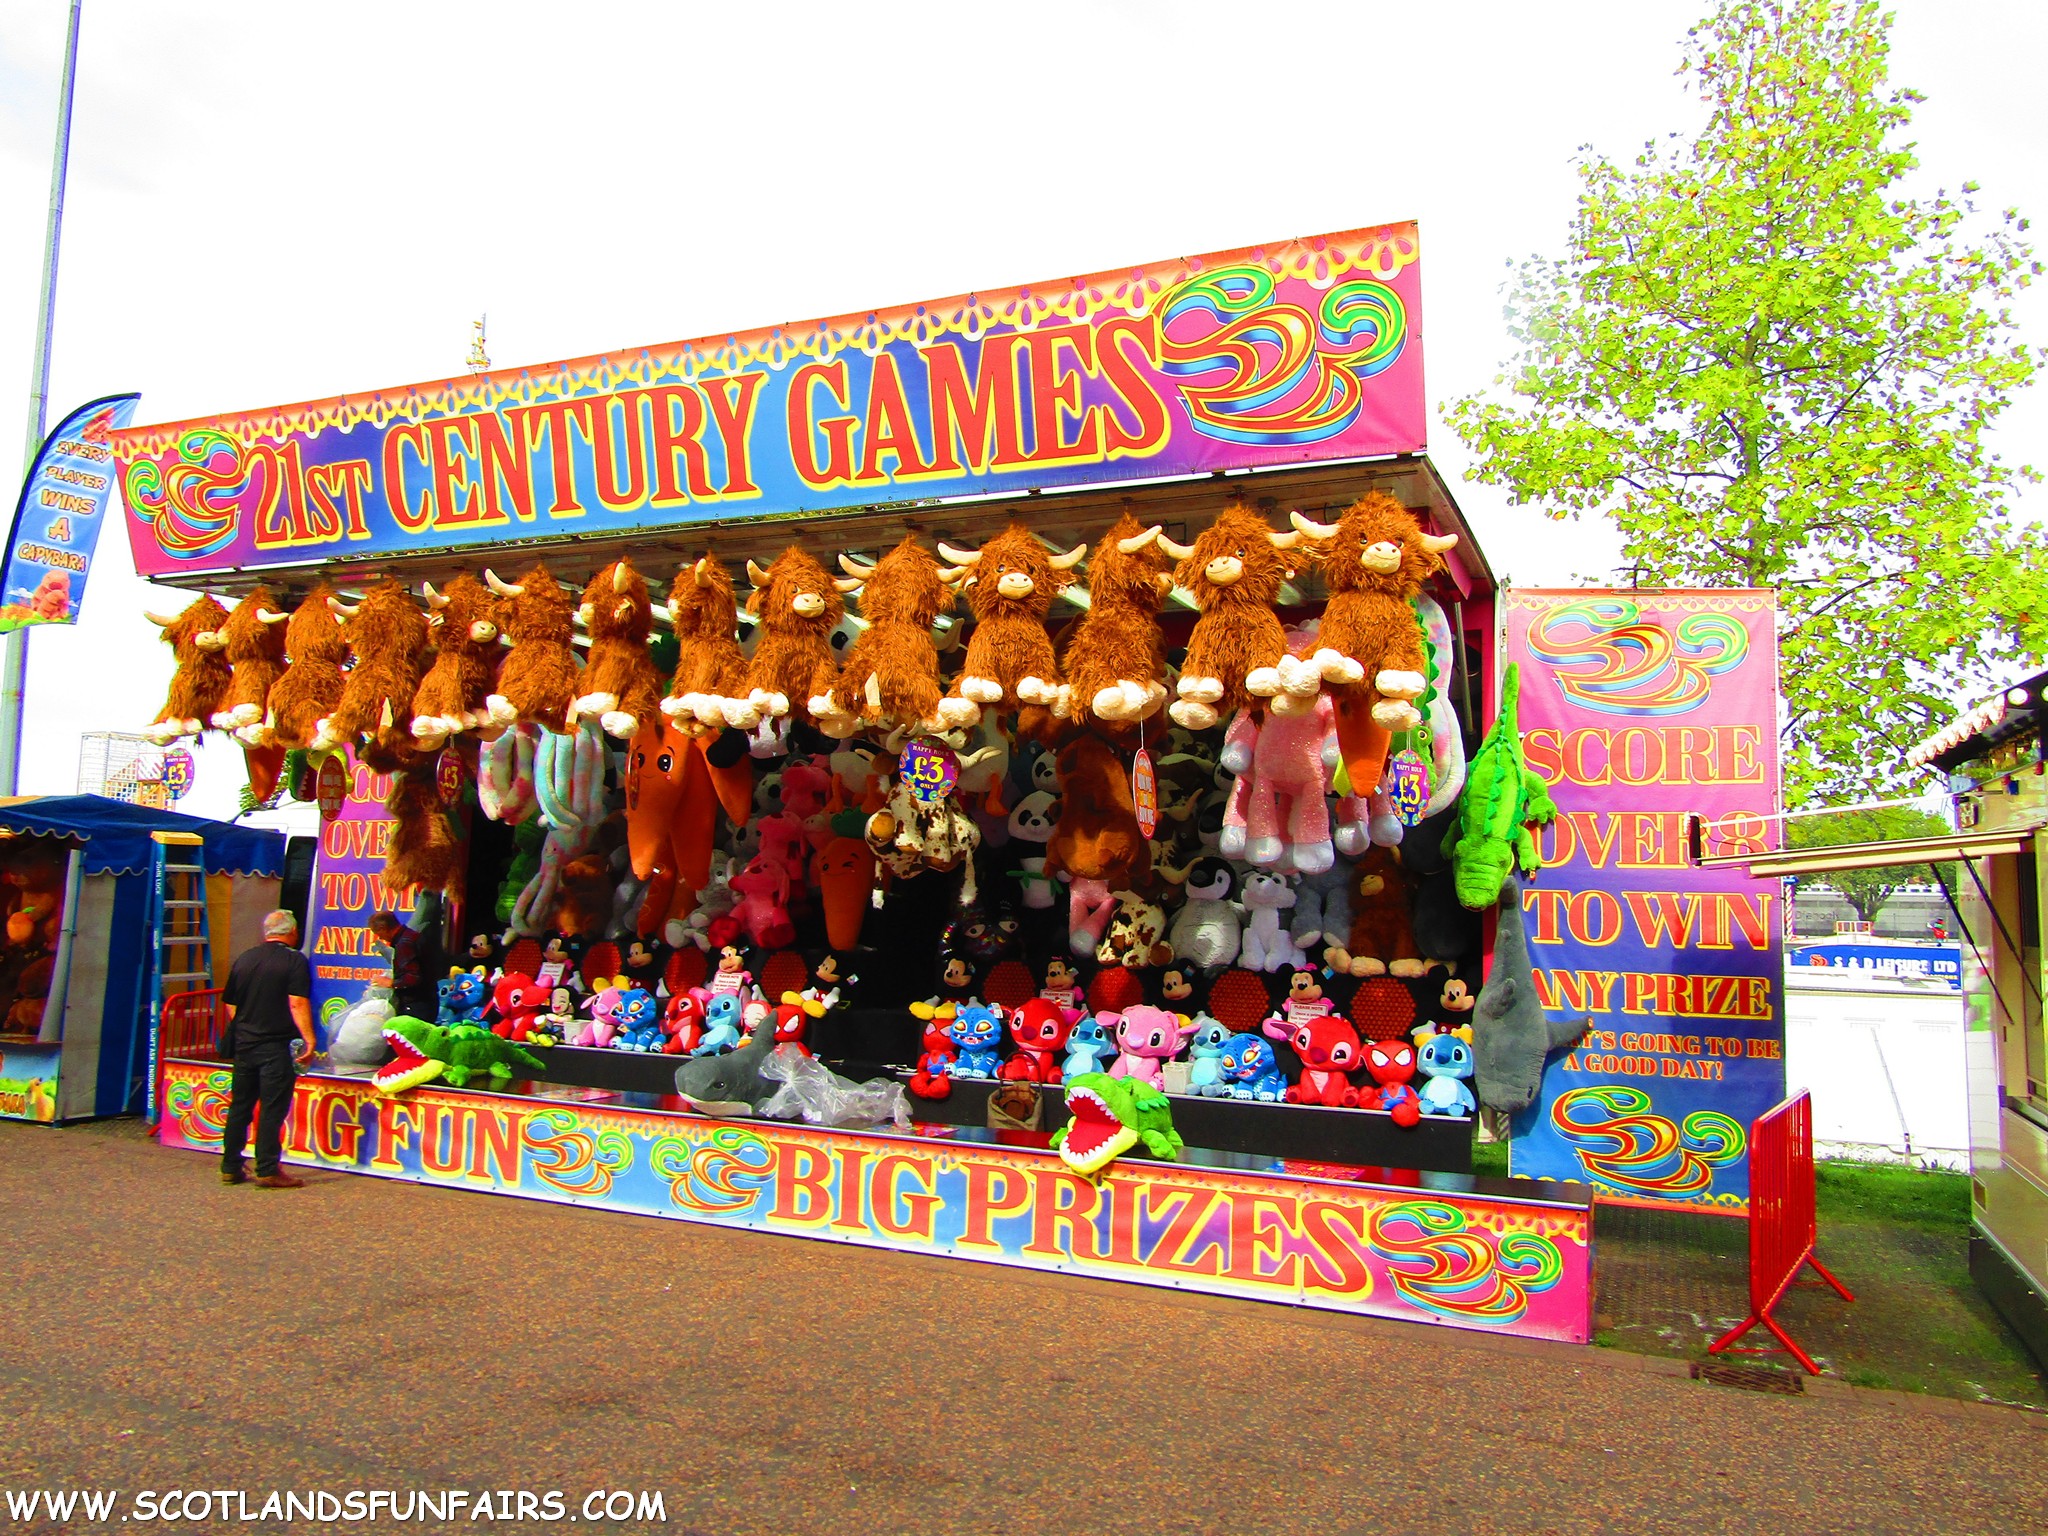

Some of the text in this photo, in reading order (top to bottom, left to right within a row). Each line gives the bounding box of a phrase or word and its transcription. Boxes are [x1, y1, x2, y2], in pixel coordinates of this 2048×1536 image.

[244, 313, 1171, 549] 21ST CENTURY GAMES
[57, 441, 112, 463] EVERY
[46, 466, 106, 490] PLAYER
[41, 489, 96, 515] WINS
[49, 518, 71, 542] A
[18, 543, 86, 572] CAPYBARA
[912, 755, 944, 783] £3
[1521, 725, 1764, 786] SCORE
[168, 763, 187, 785] £3
[1399, 774, 1421, 805] £3
[324, 819, 399, 859] OVE
[322, 872, 368, 911] TO
[1523, 889, 1773, 950] TO WIN
[314, 926, 363, 956] ANY
[1876, 957, 1929, 972] LEISURE
[1933, 960, 1957, 973] LTD
[1621, 972, 1773, 1020] PRIZE
[1620, 1032, 1701, 1055] GOING
[1705, 1036, 1743, 1058] TO
[1746, 1038, 1781, 1059] BE
[1562, 1052, 1725, 1080] A GOOD DAY!
[248, 1085, 527, 1188] IG FUN
[766, 1140, 1375, 1302] BIG PRIZES
